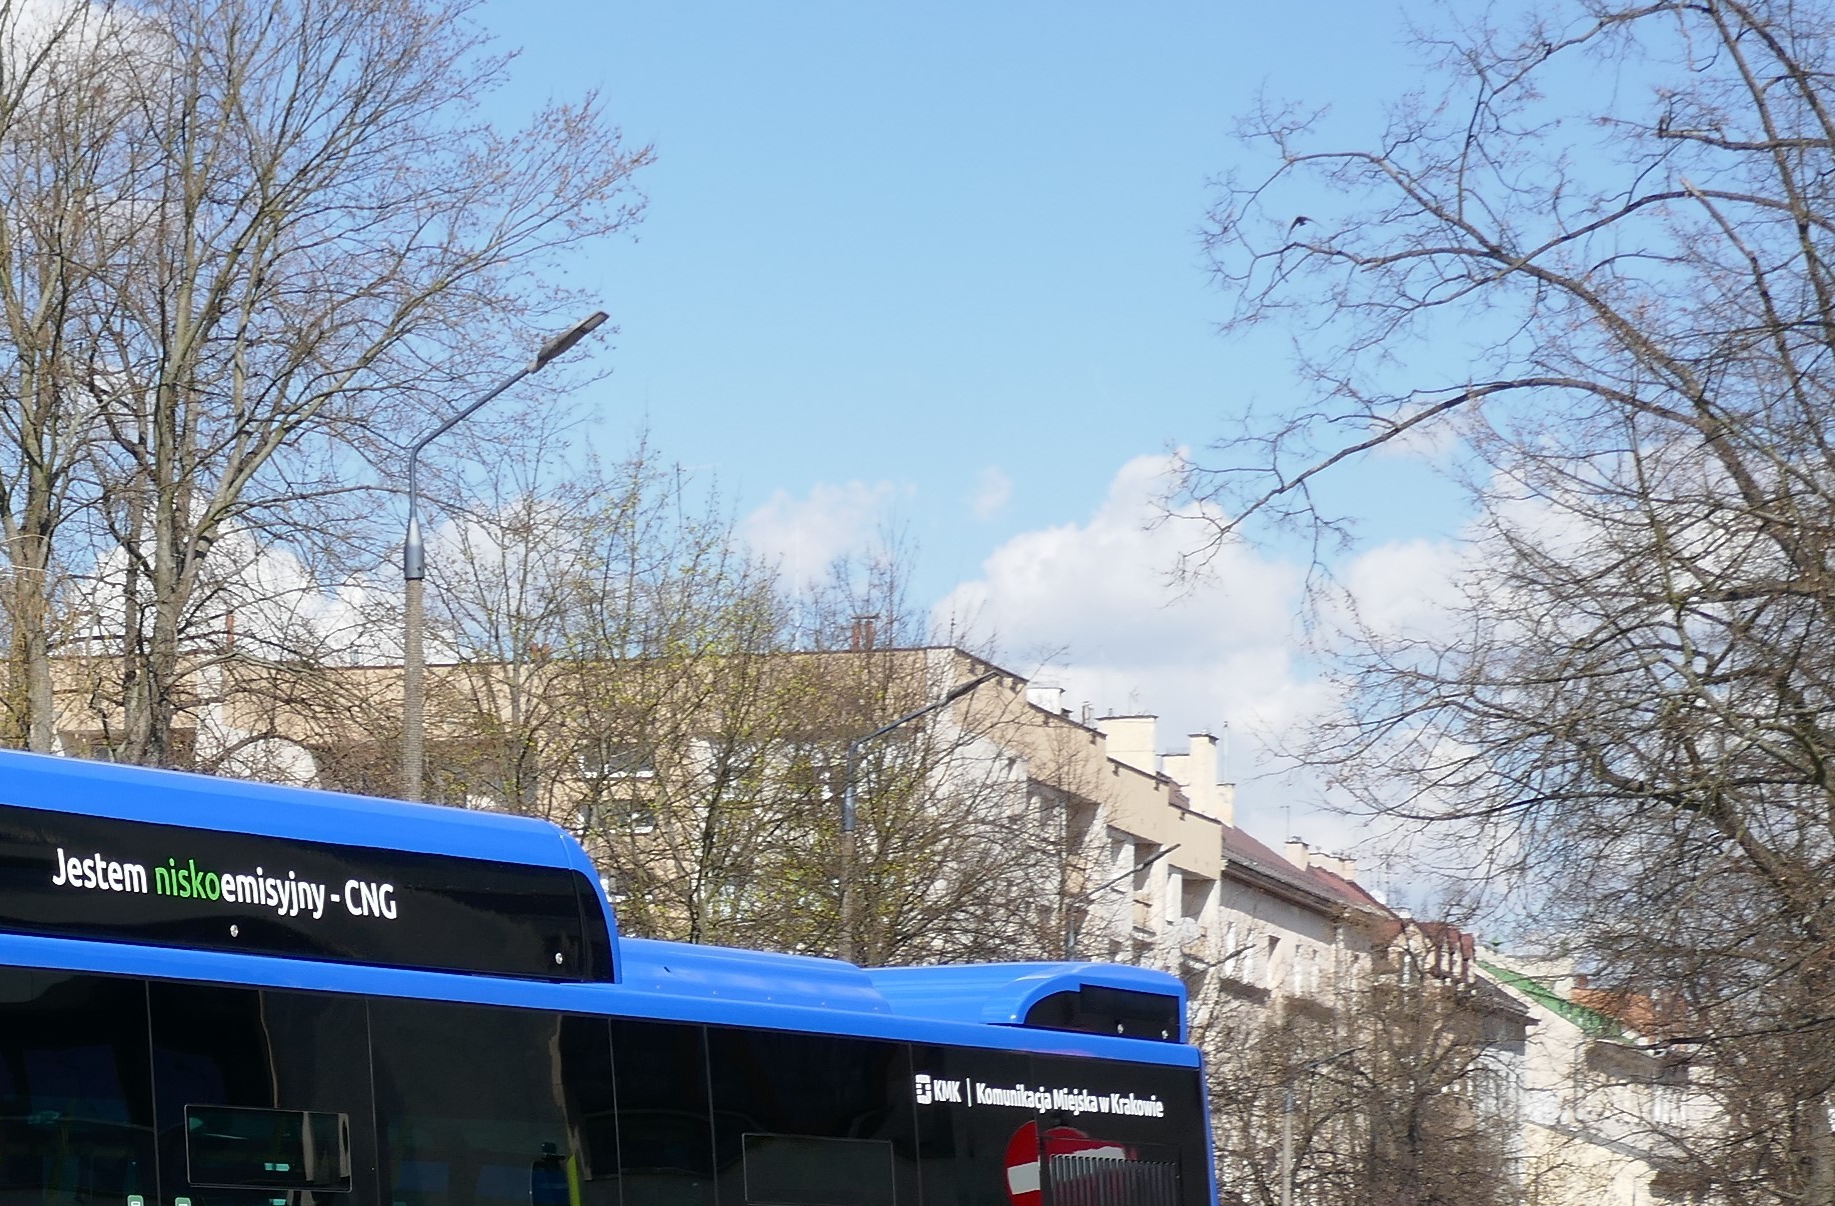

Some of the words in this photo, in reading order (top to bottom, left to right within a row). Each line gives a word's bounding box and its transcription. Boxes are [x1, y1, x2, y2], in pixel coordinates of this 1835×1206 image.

[52, 848, 147, 893] Jestem
[154, 857, 325, 919] niskoemisyjny
[344, 879, 397, 919] CNG
[933, 1079, 962, 1103] KMK
[975, 1083, 1052, 1114] Komunikacja
[1053, 1088, 1098, 1116] Miejska
[1098, 1097, 1110, 1114] w
[1110, 1092, 1164, 1118] Krakowie
